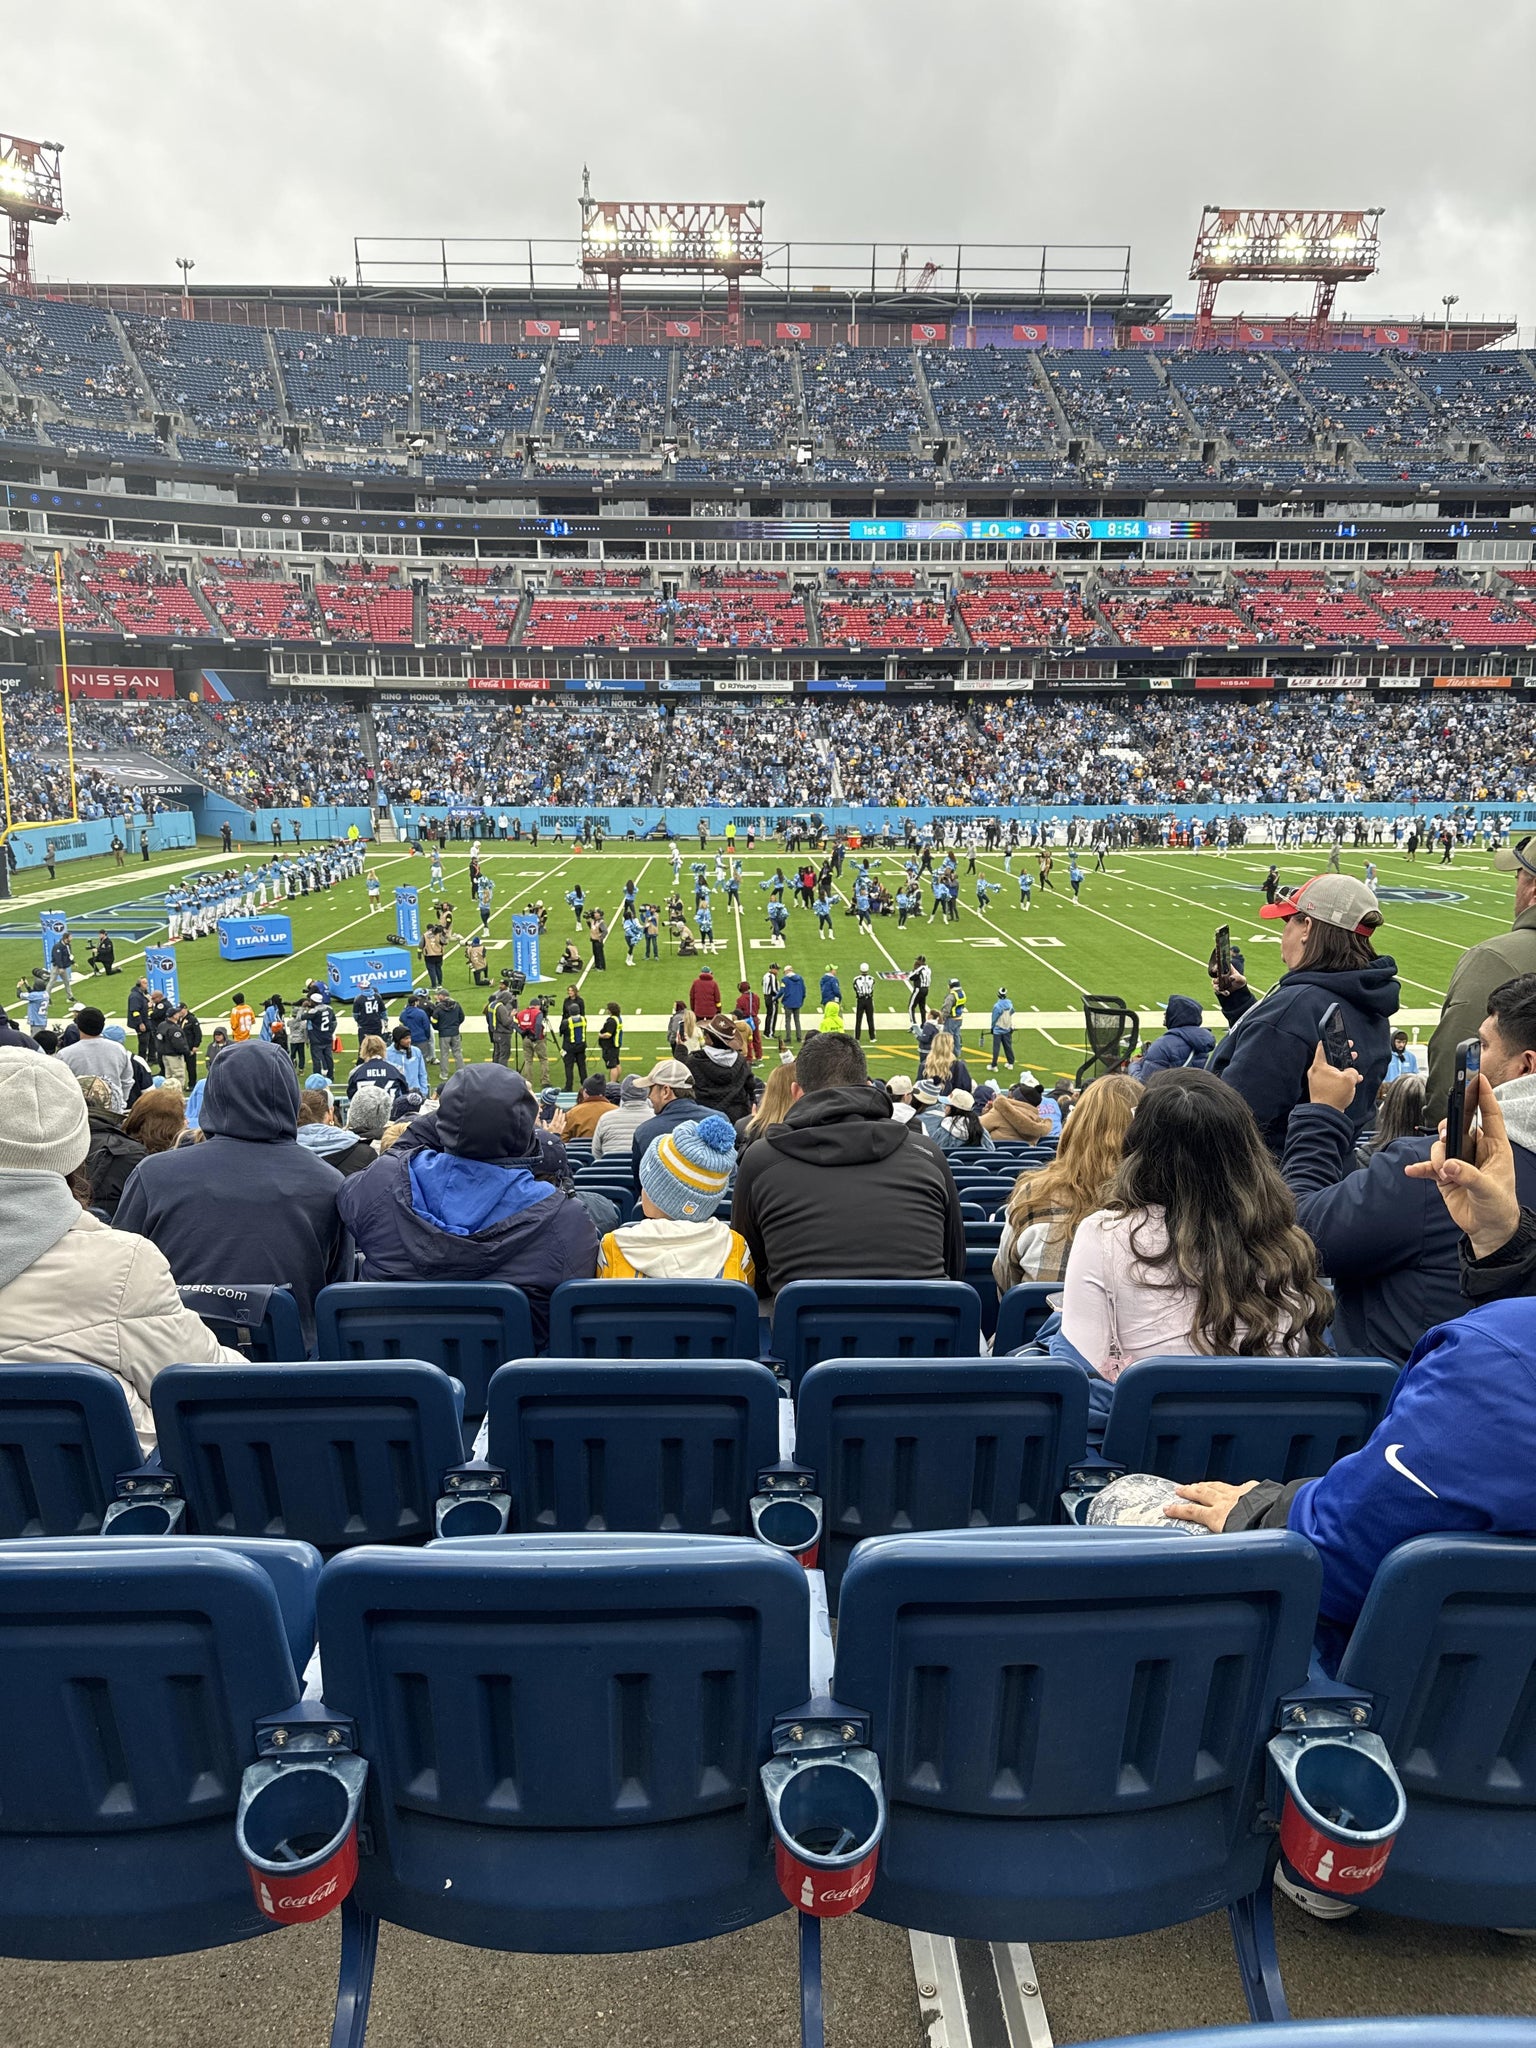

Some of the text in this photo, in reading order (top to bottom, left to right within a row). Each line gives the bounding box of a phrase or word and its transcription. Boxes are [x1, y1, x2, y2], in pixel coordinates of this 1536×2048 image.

[863, 525, 887, 536] 1st &
[988, 523, 999, 537] 0
[1029, 523, 1040, 537] 0
[1107, 523, 1140, 537] 8:54
[1147, 525, 1162, 535] 1st
[0, 678, 21, 693] ger
[71, 673, 159, 688] NISSAN
[478, 680, 500, 689] Coca-Cola
[518, 680, 541, 689] Coca-Cola
[728, 682, 757, 691] RJYoung
[1446, 678, 1468, 687] Tito's
[380, 693, 402, 701] RING
[235, 933, 287, 946] TITAN UP
[530, 940, 538, 977] TITAN UP
[350, 969, 407, 984] TITAN UP
[364, 1000, 379, 1014] 84
[321, 1017, 330, 1032] 2
[278, 1873, 339, 1909] Coca-Cola
[820, 1868, 873, 1903] Coca-Cola
